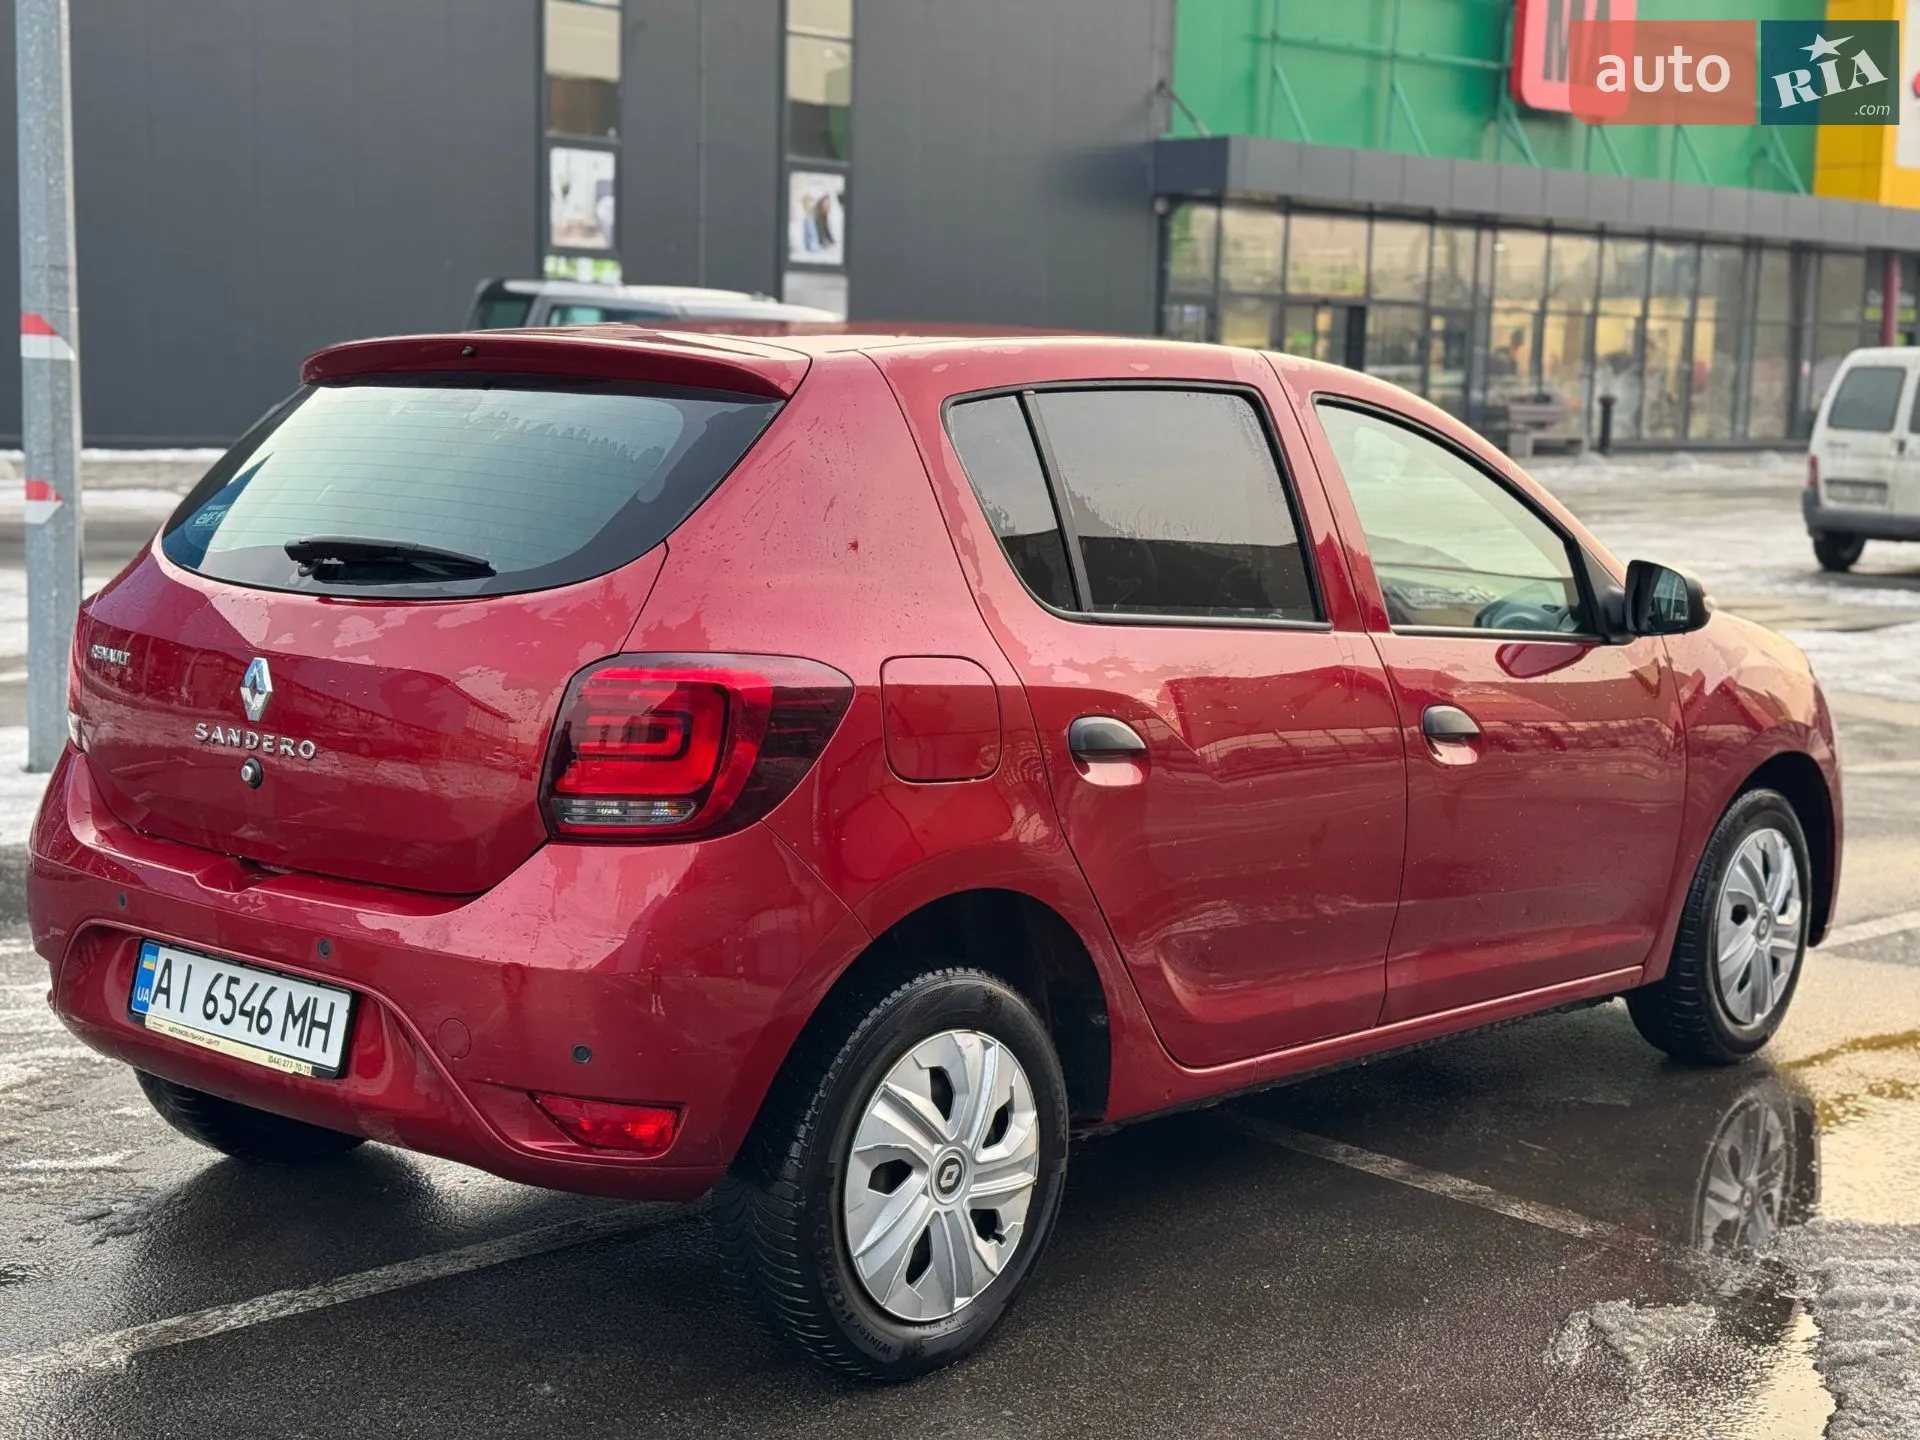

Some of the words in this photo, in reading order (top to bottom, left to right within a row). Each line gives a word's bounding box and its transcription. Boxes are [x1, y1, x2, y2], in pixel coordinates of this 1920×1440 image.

[194, 722, 317, 760] SANDERO
[137, 986, 150, 1003] UA
[151, 958, 193, 1014] AI
[202, 972, 278, 1035] 6546
[279, 991, 336, 1053] MH
